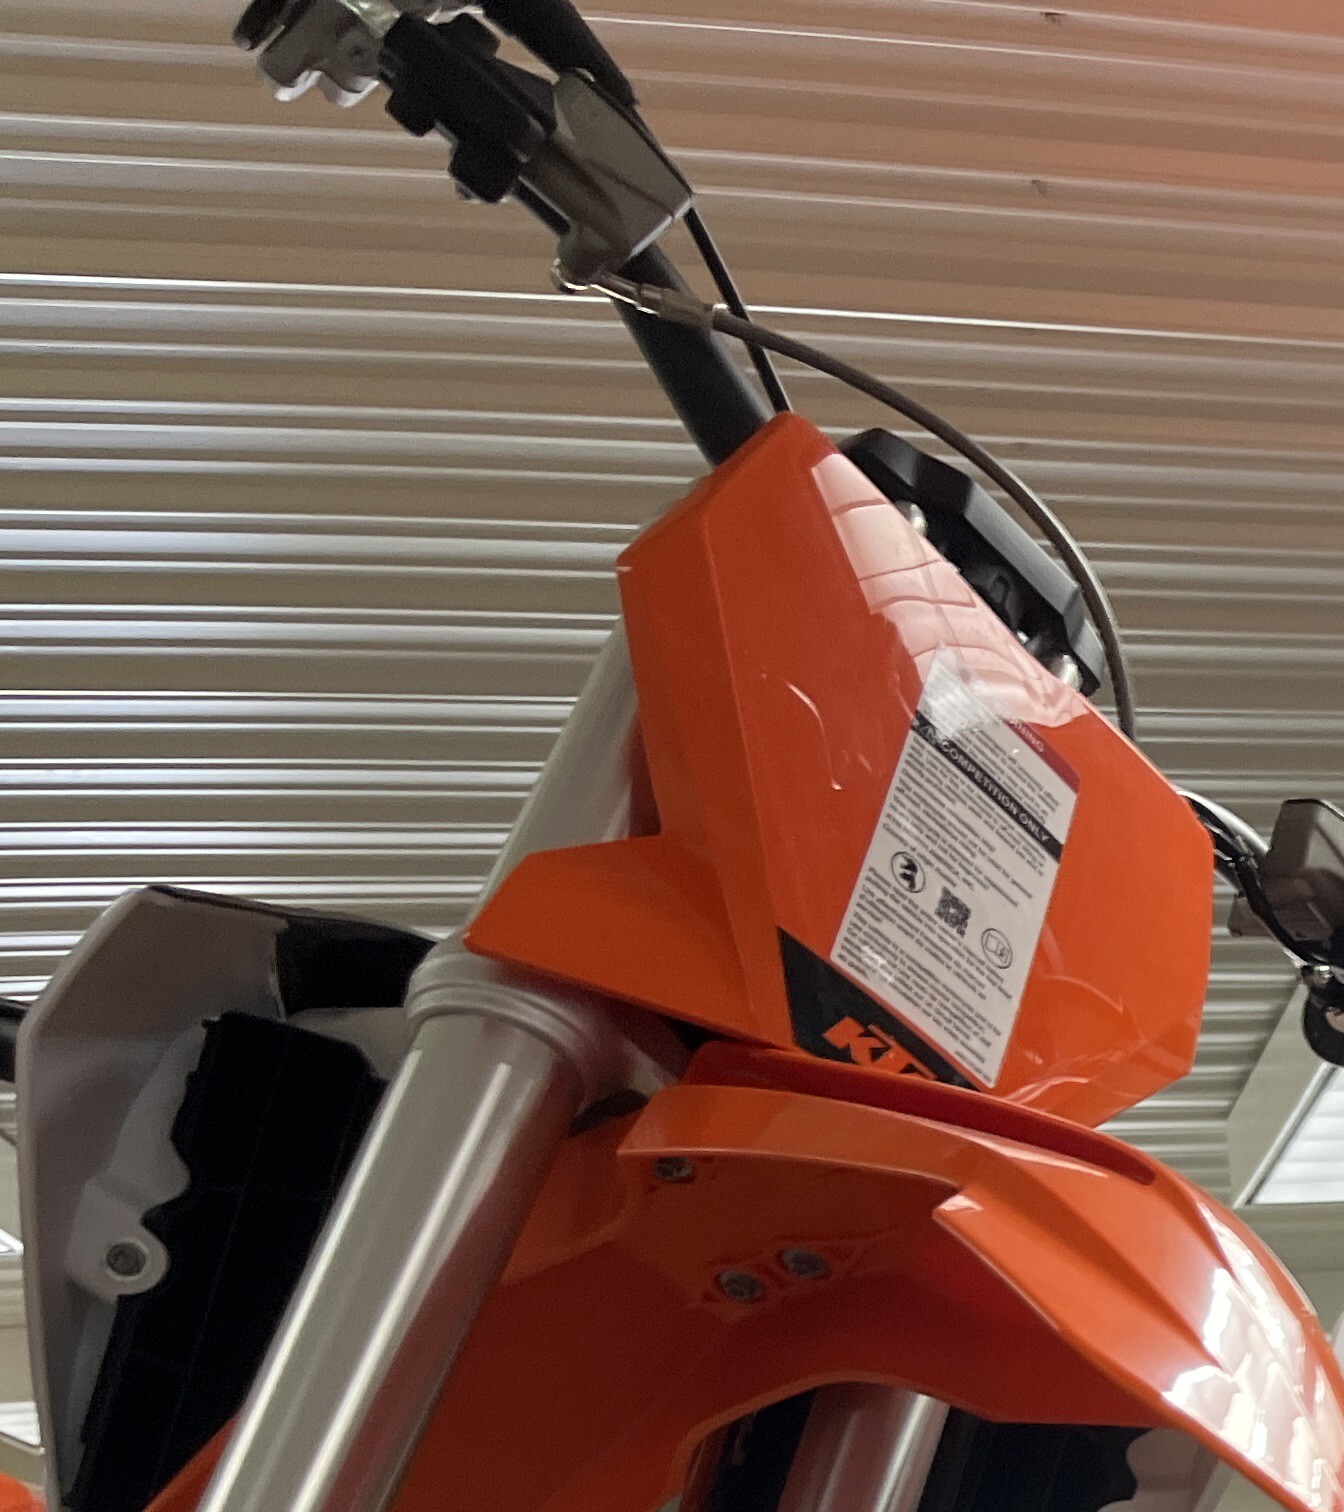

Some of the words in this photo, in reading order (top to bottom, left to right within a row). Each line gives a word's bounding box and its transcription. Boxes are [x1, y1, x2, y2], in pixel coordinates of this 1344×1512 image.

[942, 740, 1018, 816] COMPETITION
[1019, 813, 1050, 841] ONLY
[823, 1016, 938, 1080] KT
